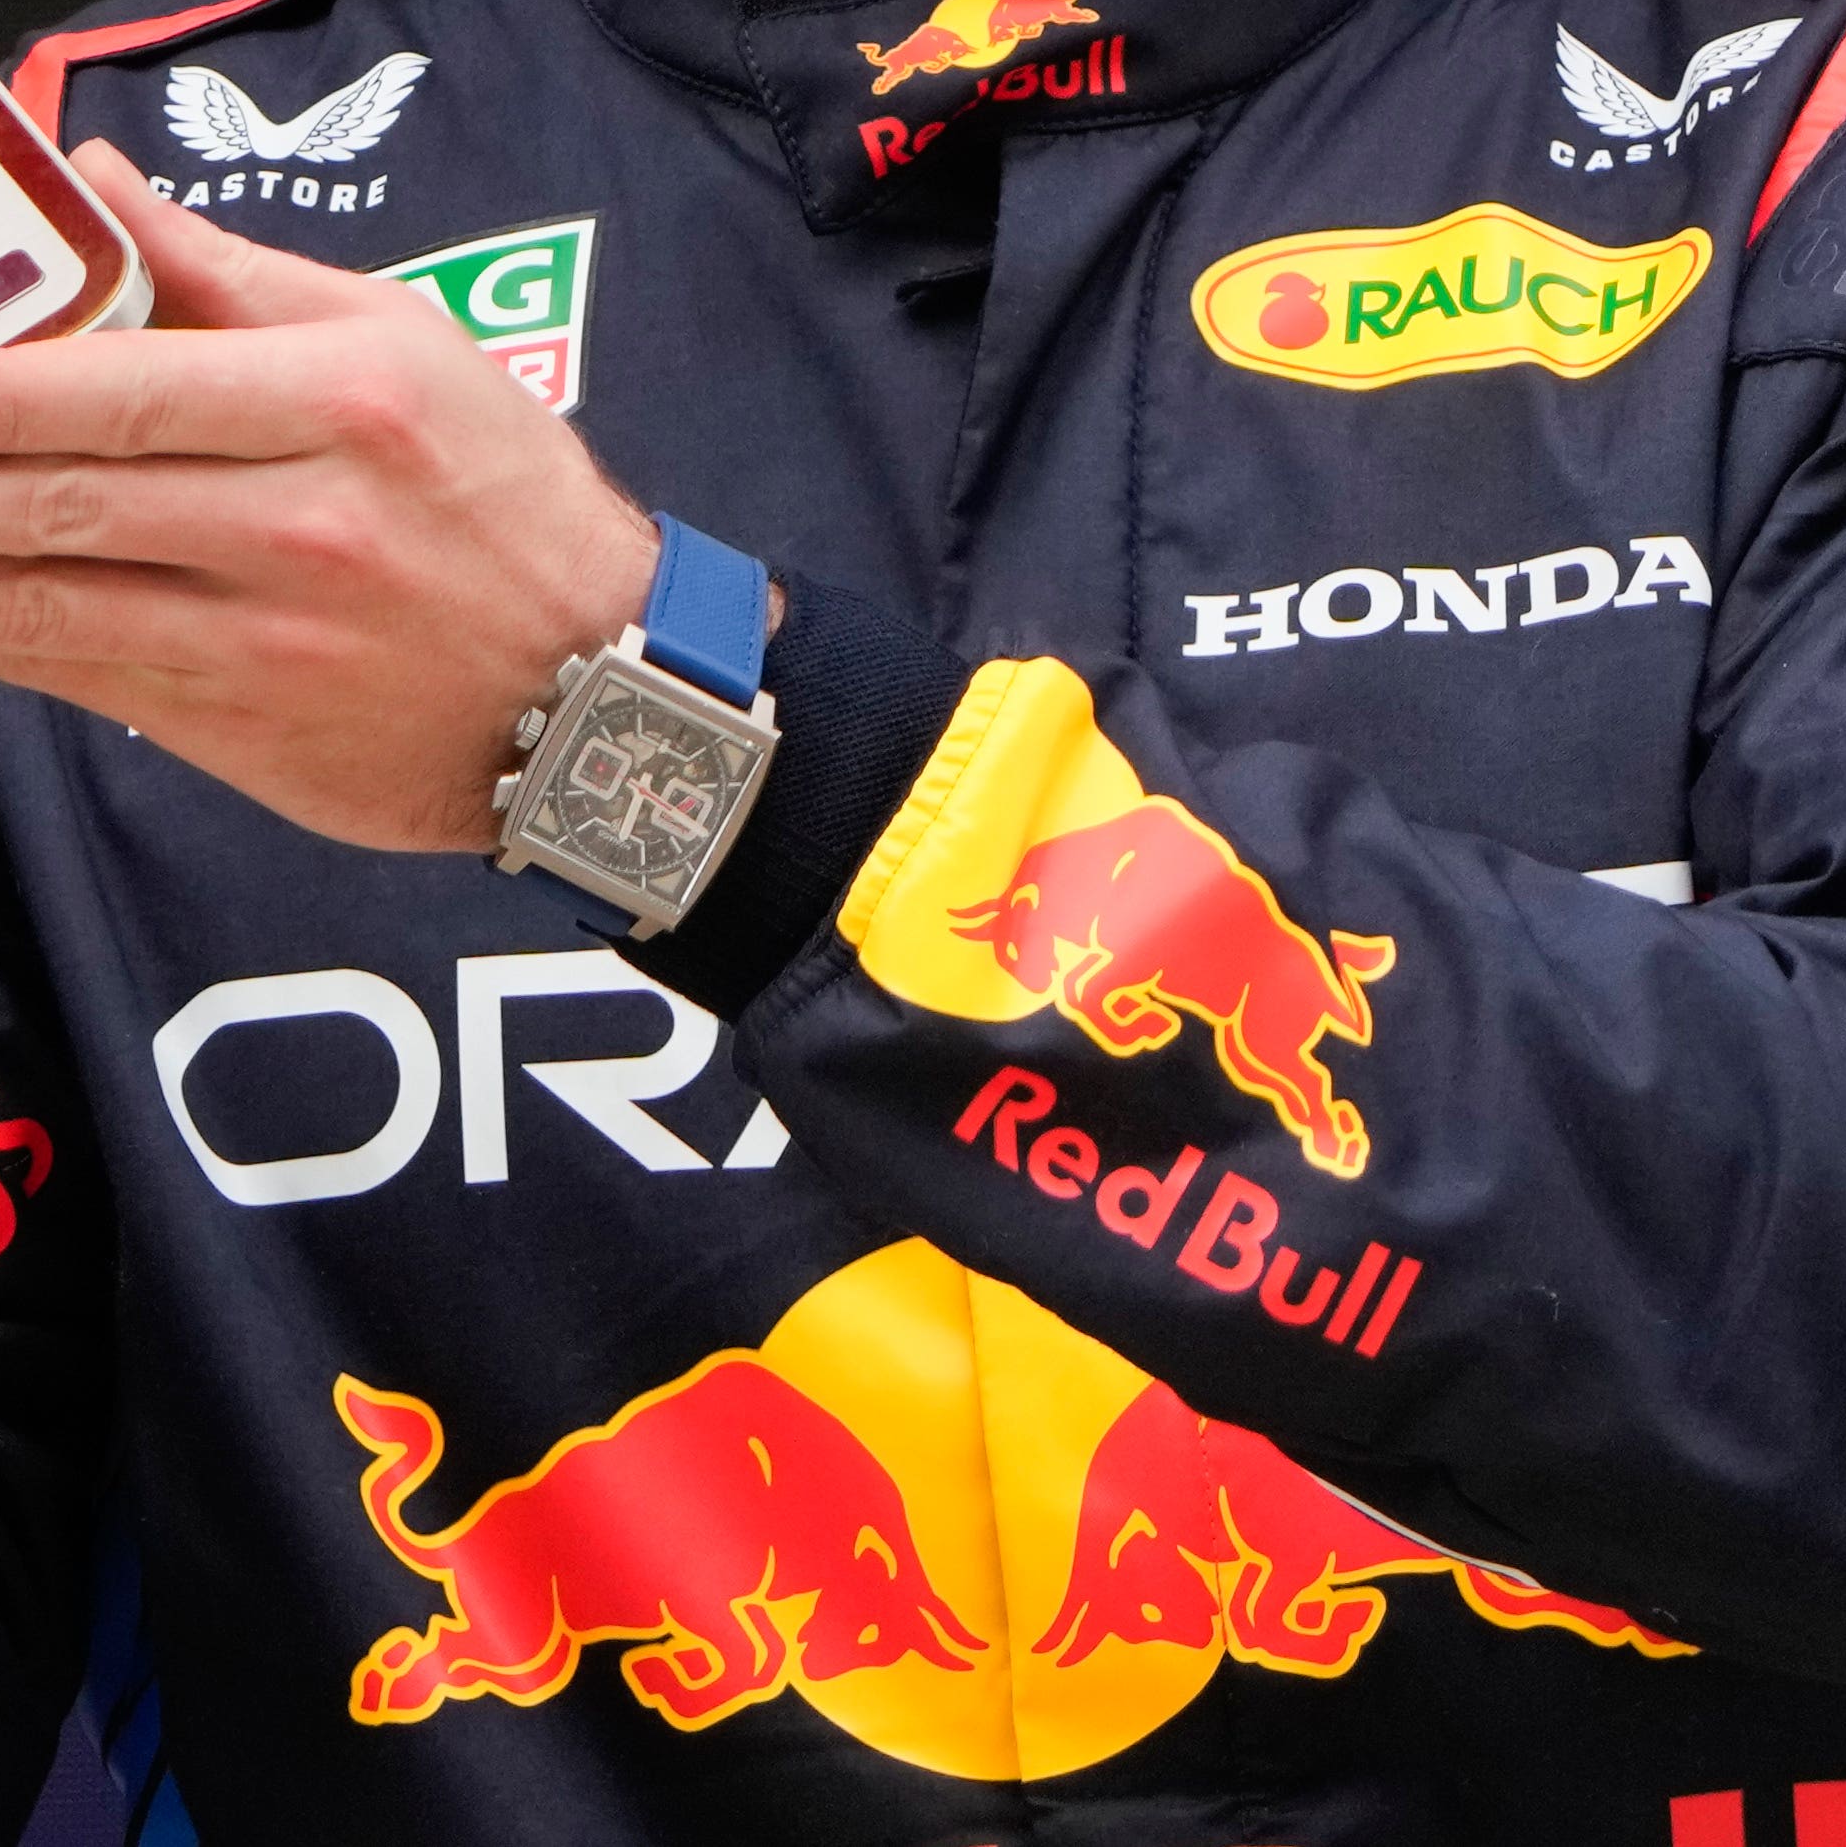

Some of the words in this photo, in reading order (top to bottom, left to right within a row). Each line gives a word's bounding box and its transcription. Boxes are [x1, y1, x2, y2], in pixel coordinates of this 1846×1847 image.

[992, 34, 1127, 101] Bull
[149, 170, 389, 213] CASTORE
[1344, 256, 1659, 345] RAUCH
[1182, 535, 1713, 659] HONDA
[153, 949, 793, 1206] OR
[955, 1064, 1205, 1249] Red
[1174, 1168, 1423, 1359] Bull
